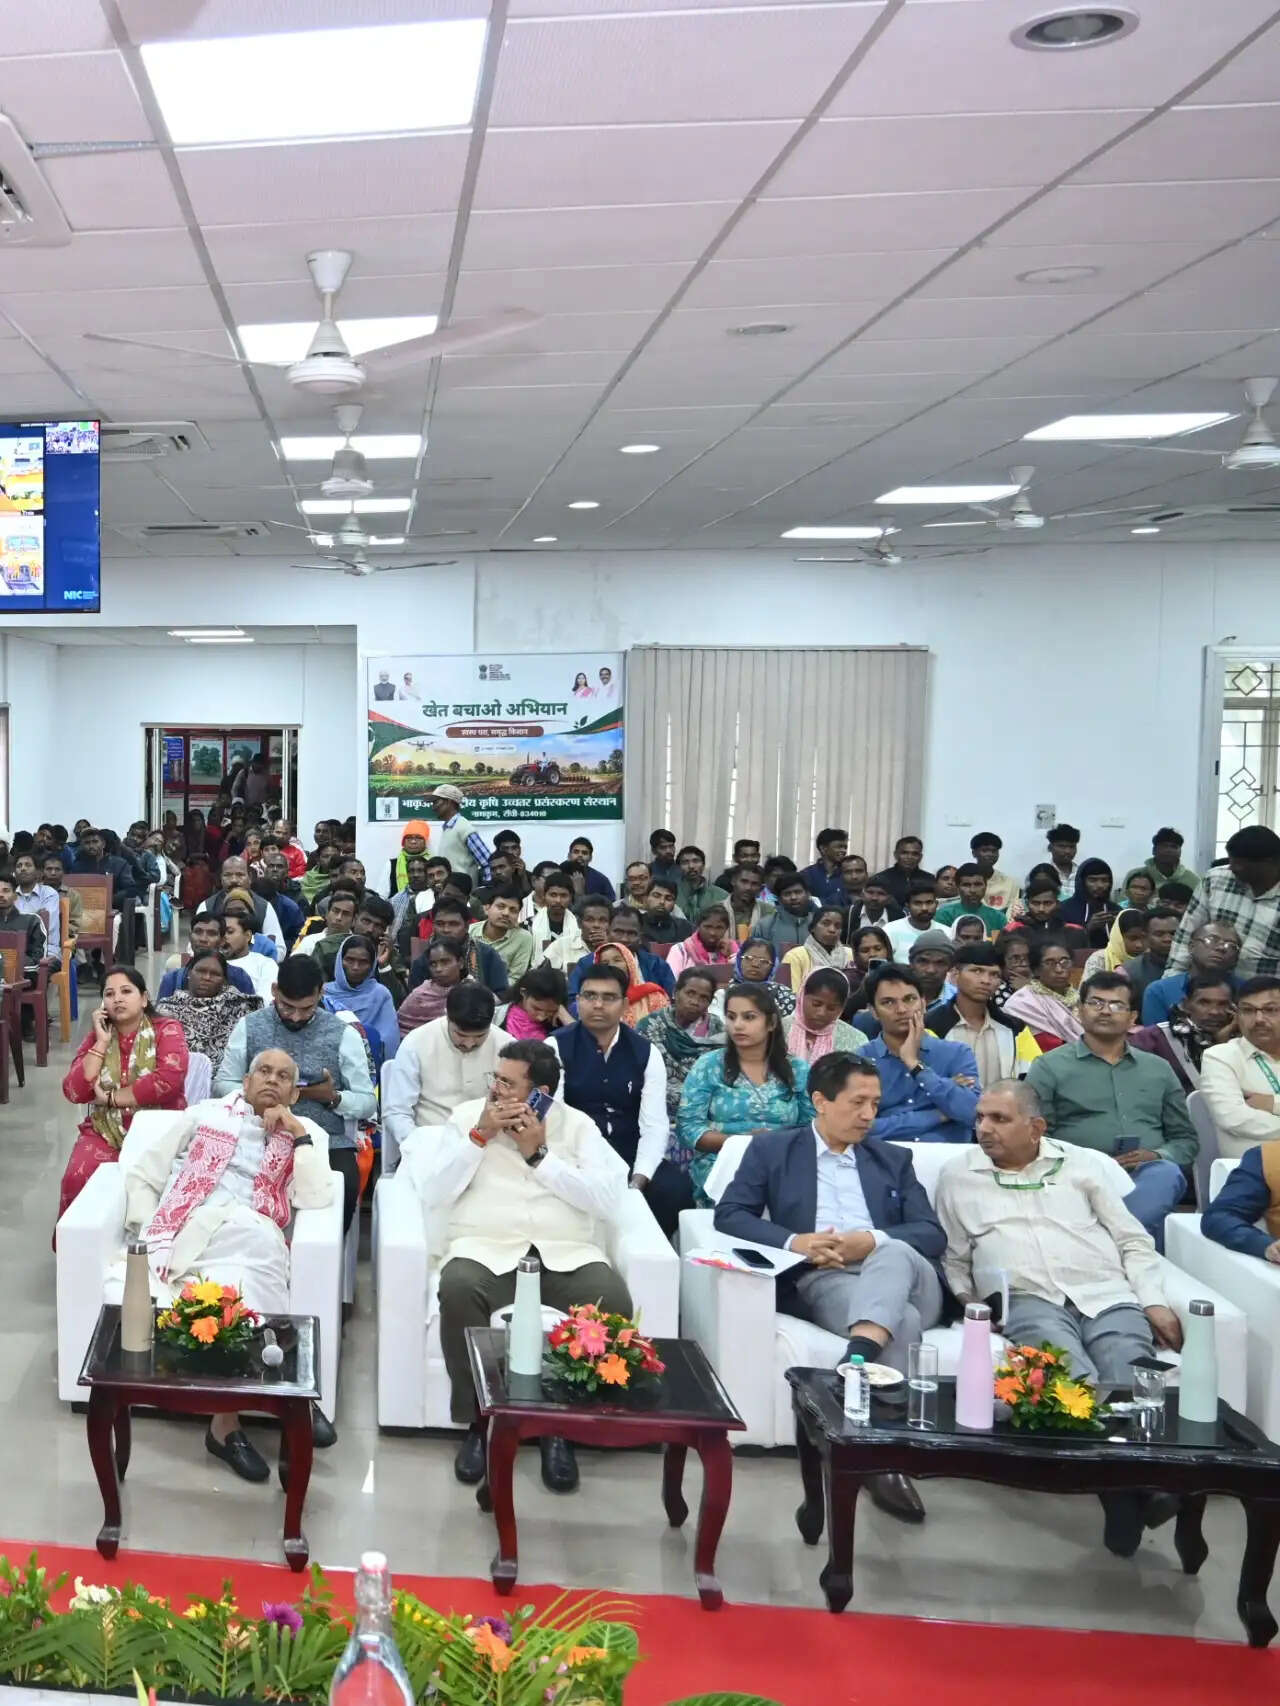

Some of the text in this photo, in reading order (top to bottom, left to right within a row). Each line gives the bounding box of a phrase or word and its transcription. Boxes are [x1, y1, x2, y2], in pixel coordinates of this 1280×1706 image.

[64, 591, 82, 600] NIC
[422, 698, 568, 717] खेत बचाओ अभियान
[479, 797, 499, 809] कृषि
[502, 797, 531, 807] उच्चतर
